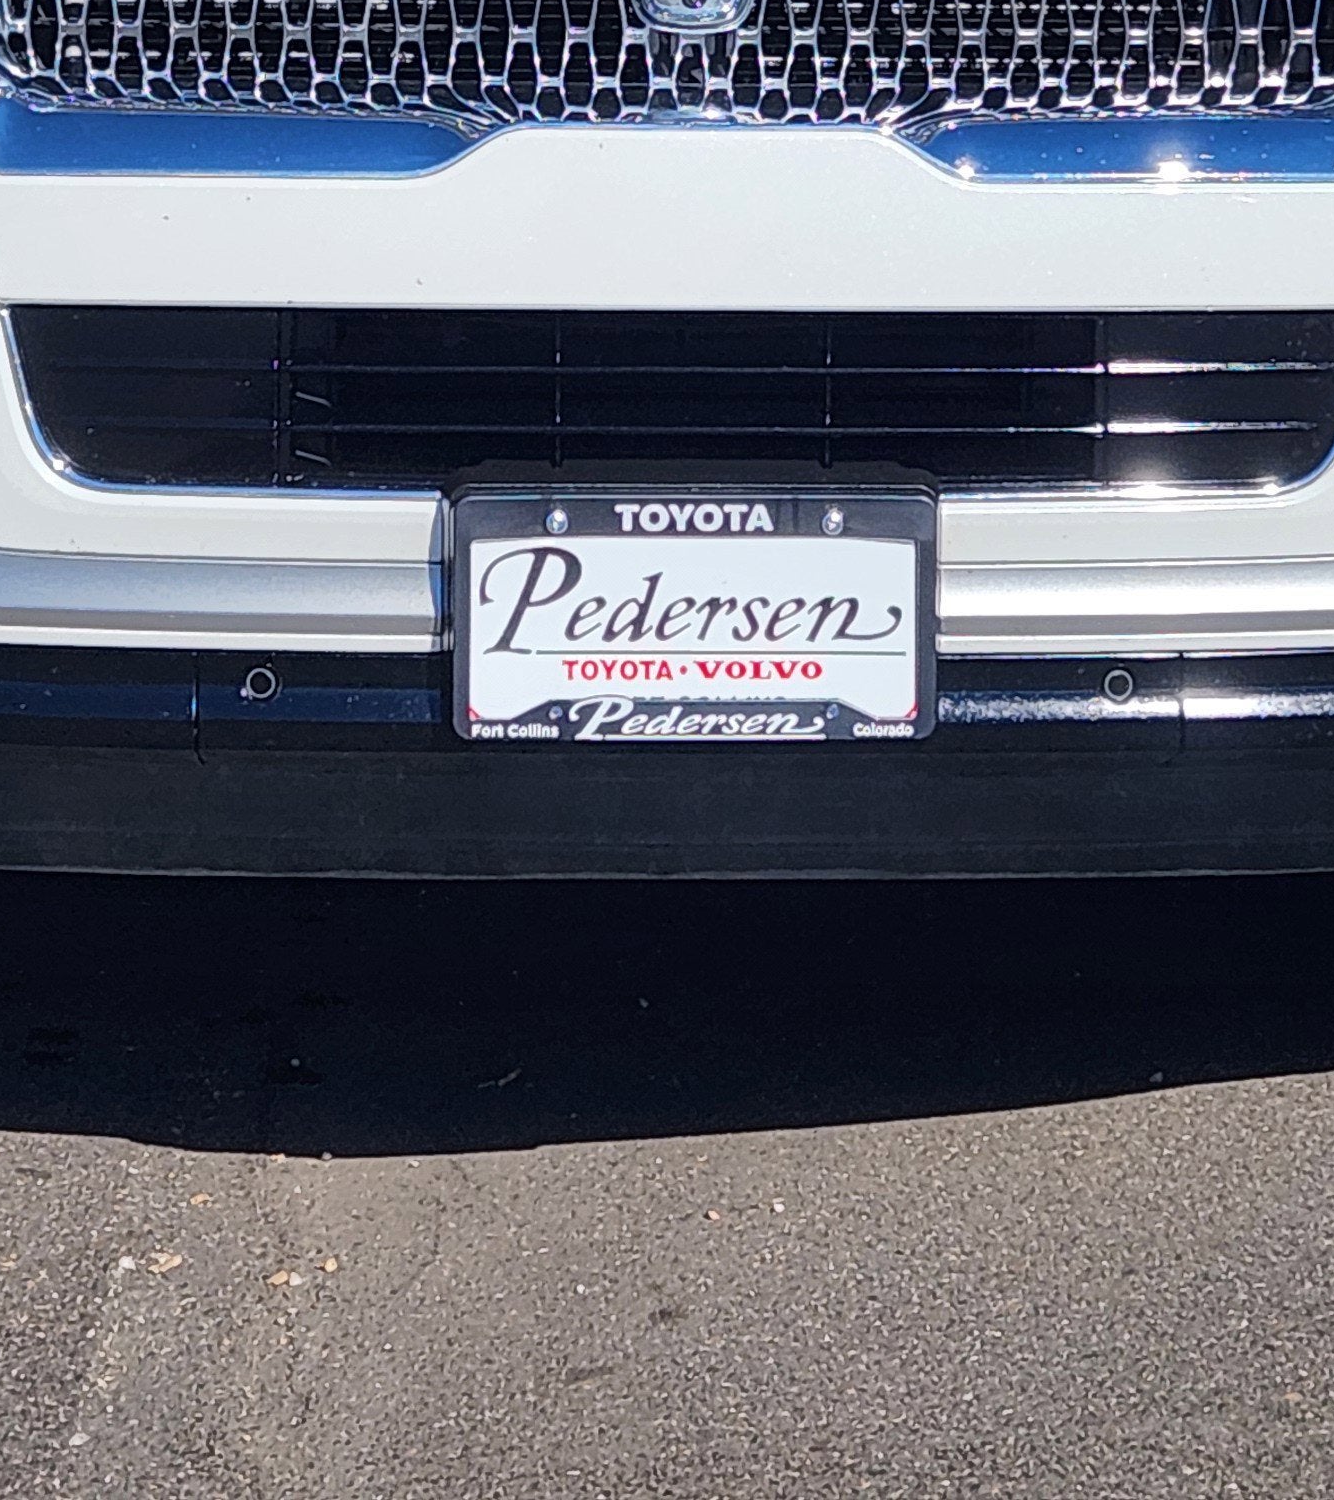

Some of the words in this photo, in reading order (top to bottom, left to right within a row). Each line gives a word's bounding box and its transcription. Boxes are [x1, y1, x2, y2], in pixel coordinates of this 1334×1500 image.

[614, 503, 774, 533] TOYOTA
[478, 545, 904, 655] Pedersen
[562, 660, 673, 681] TOYOTA
[694, 660, 823, 680] VOLVO
[470, 723, 504, 740] Fort
[507, 722, 560, 740] Collins
[568, 696, 826, 742] Pedersen
[852, 721, 915, 740] Colorado
